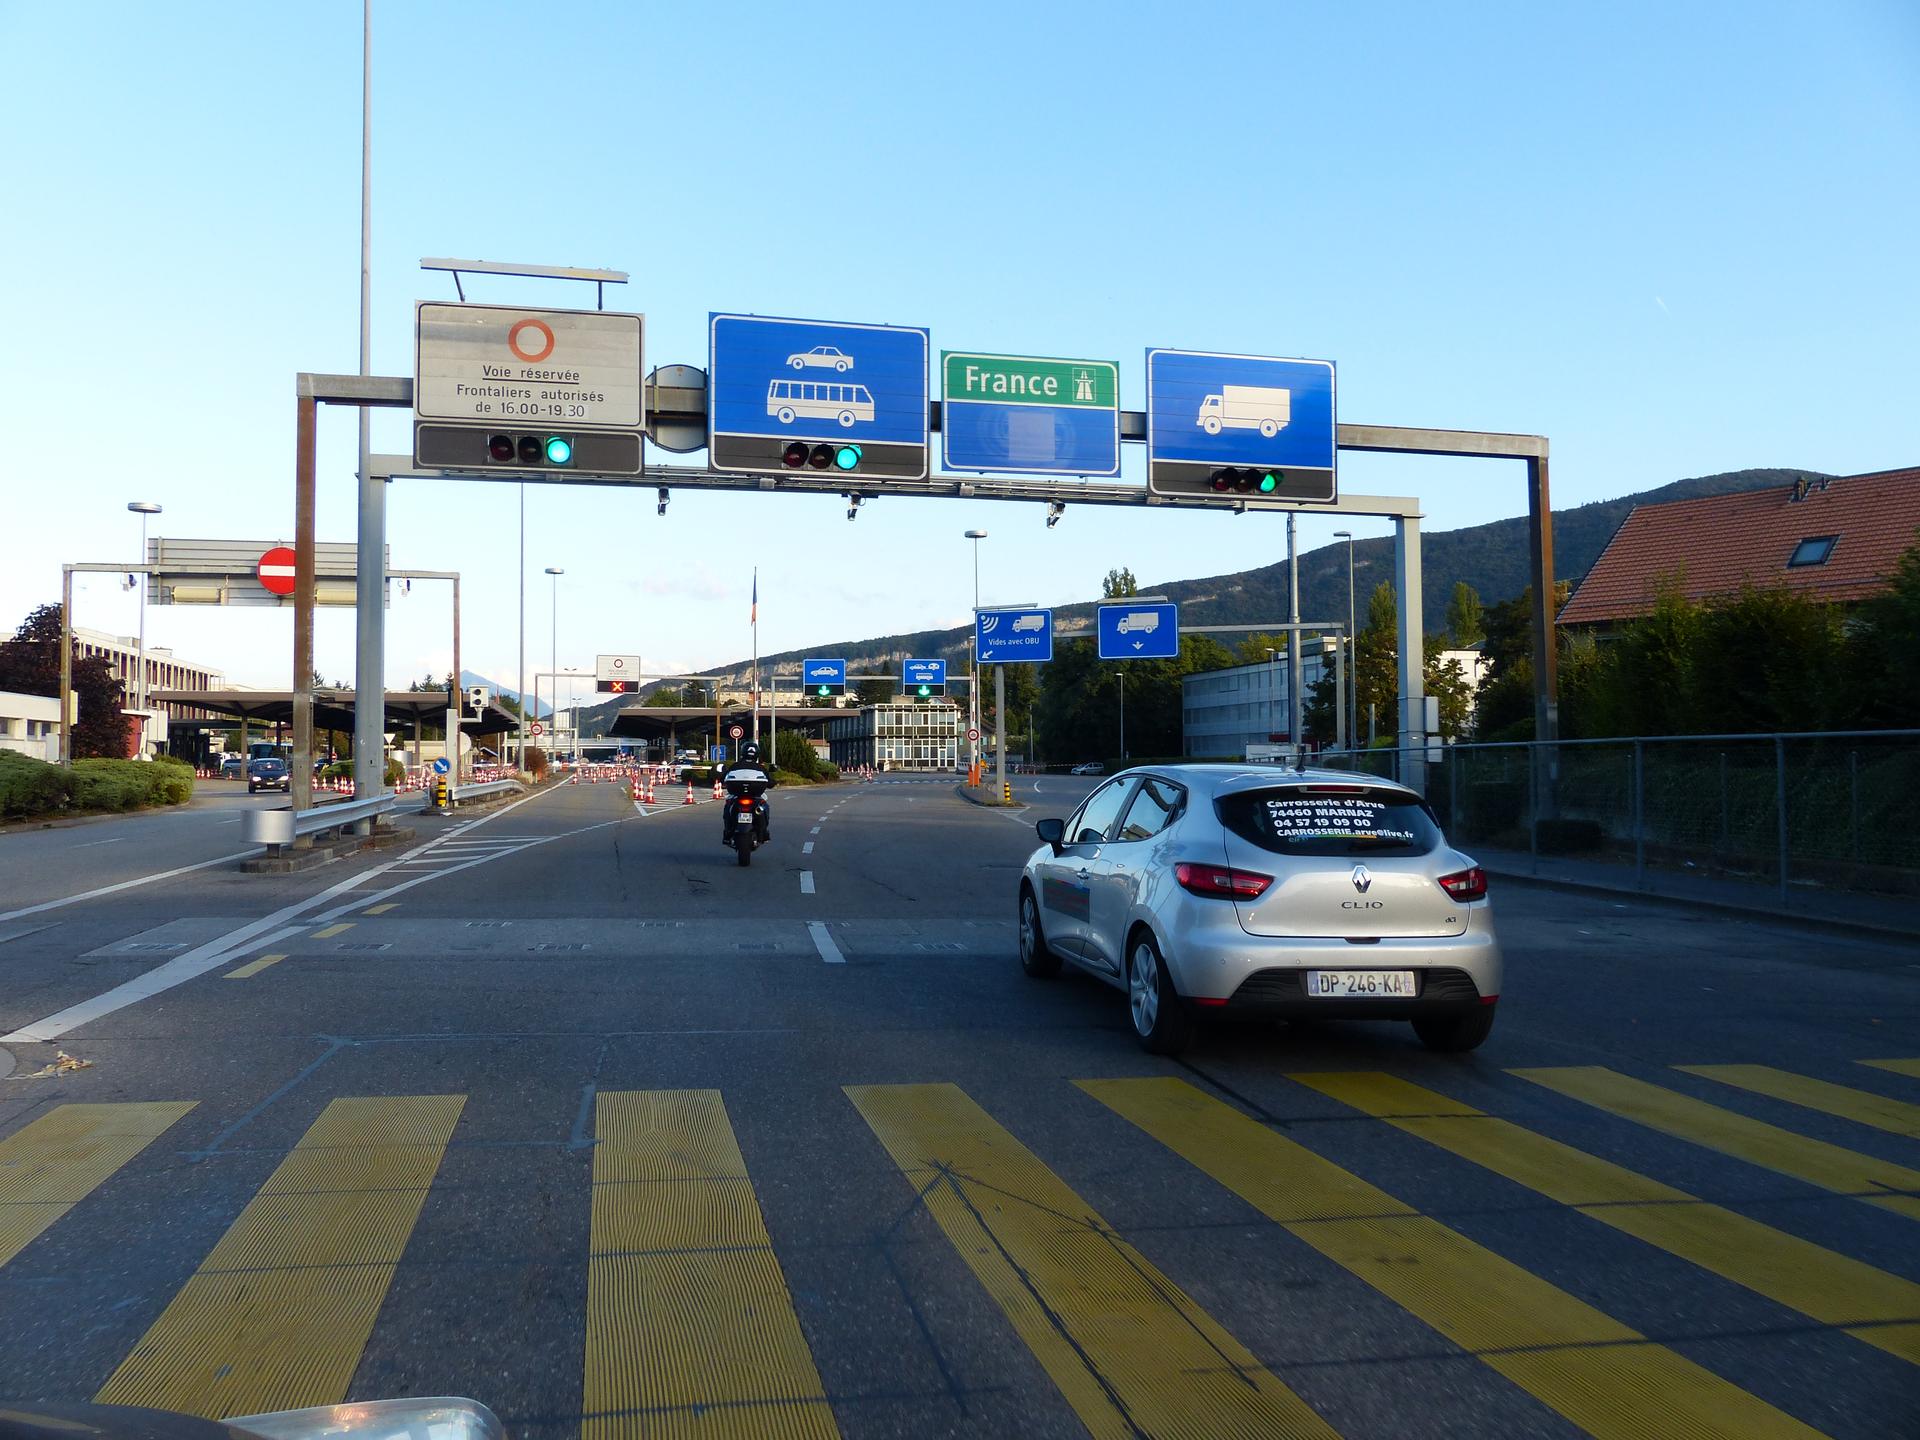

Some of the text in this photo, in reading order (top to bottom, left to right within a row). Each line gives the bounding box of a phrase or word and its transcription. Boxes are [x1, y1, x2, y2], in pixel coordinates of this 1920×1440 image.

[483, 365, 580, 381] Voie réservée
[966, 366, 1057, 396] France
[456, 384, 604, 402] Frontaliers autorisés
[475, 401, 585, 417] de 16.00-19.30
[988, 637, 1006, 646] Vides
[1024, 637, 1040, 645] OBU
[1266, 799, 1386, 809] Carrosserie d'Arve
[1269, 808, 1374, 818] 74460 MARNAZ
[1274, 818, 1371, 828] 04 57 19 09 00
[1341, 901, 1383, 909] CLIO
[1319, 974, 1403, 993] DP-246-KA
